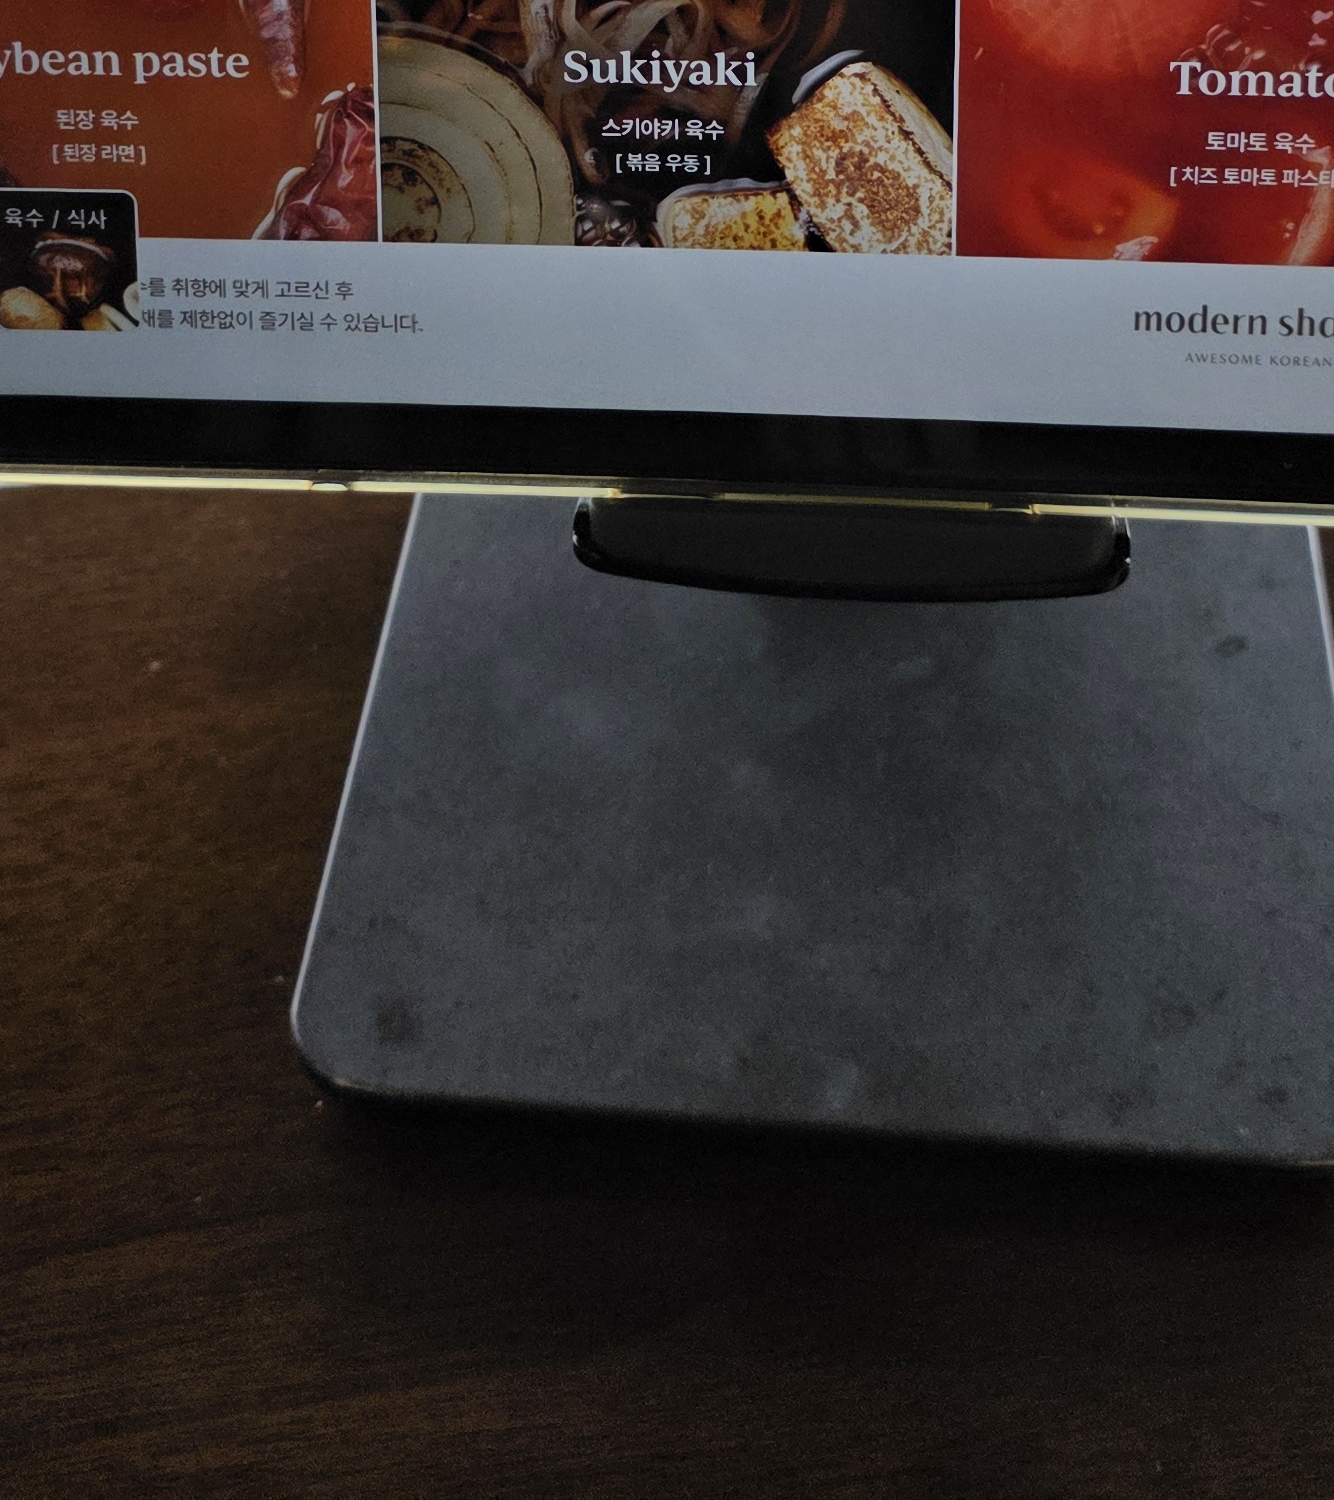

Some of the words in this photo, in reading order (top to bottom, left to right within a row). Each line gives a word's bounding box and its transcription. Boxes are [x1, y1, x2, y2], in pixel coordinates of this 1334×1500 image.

[133, 45, 249, 84] paste
[564, 50, 757, 93] Sukiyaki
[56, 109, 95, 131] 된장
[99, 109, 139, 132] 육수
[601, 118, 679, 141] 스키야키
[685, 118, 725, 142] 육수
[1205, 132, 1268, 154] 토마토
[1273, 132, 1316, 156] 육수
[1222, 166, 1277, 187] 토마토
[4, 208, 45, 228] 육수
[67, 208, 107, 230] 식사
[171, 278, 227, 299] 취향에
[232, 279, 269, 299] 맞게
[275, 280, 330, 301] 고르신
[335, 280, 354, 301] 후
[180, 310, 253, 331] 제한없이
[258, 311, 315, 332] 즐기실
[320, 313, 338, 333] 수
[343, 312, 424, 334] 있습니다.
[1133, 304, 1268, 337] modern
[1185, 353, 1263, 366] AWESOME
[1269, 355, 1333, 368] KOREAN
